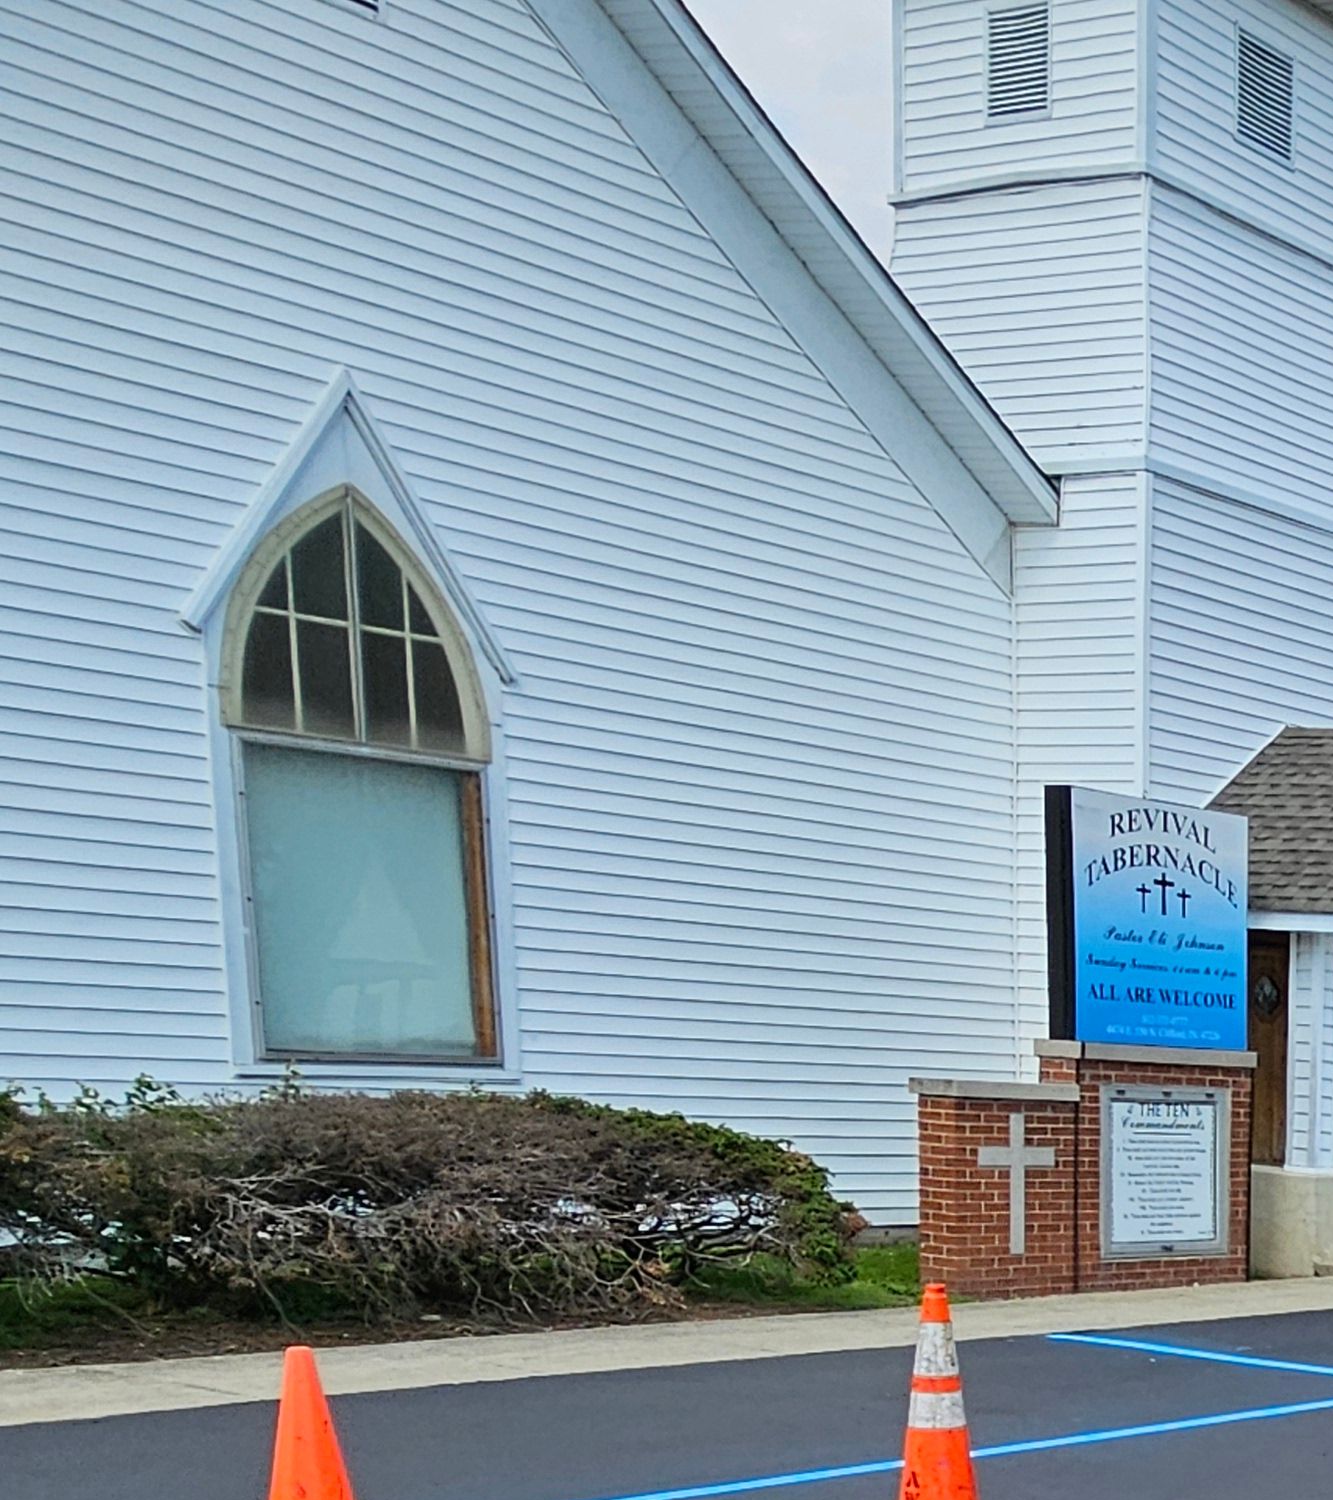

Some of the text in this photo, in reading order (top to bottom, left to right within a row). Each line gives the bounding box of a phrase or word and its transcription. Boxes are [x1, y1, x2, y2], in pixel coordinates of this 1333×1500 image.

[1109, 808, 1217, 855] REVIVAL
[1084, 843, 1238, 910] TABERNACLE
[1088, 983, 1237, 1010] ALL ARE WELCOME
[1139, 1102, 1190, 1118] THE TEN
